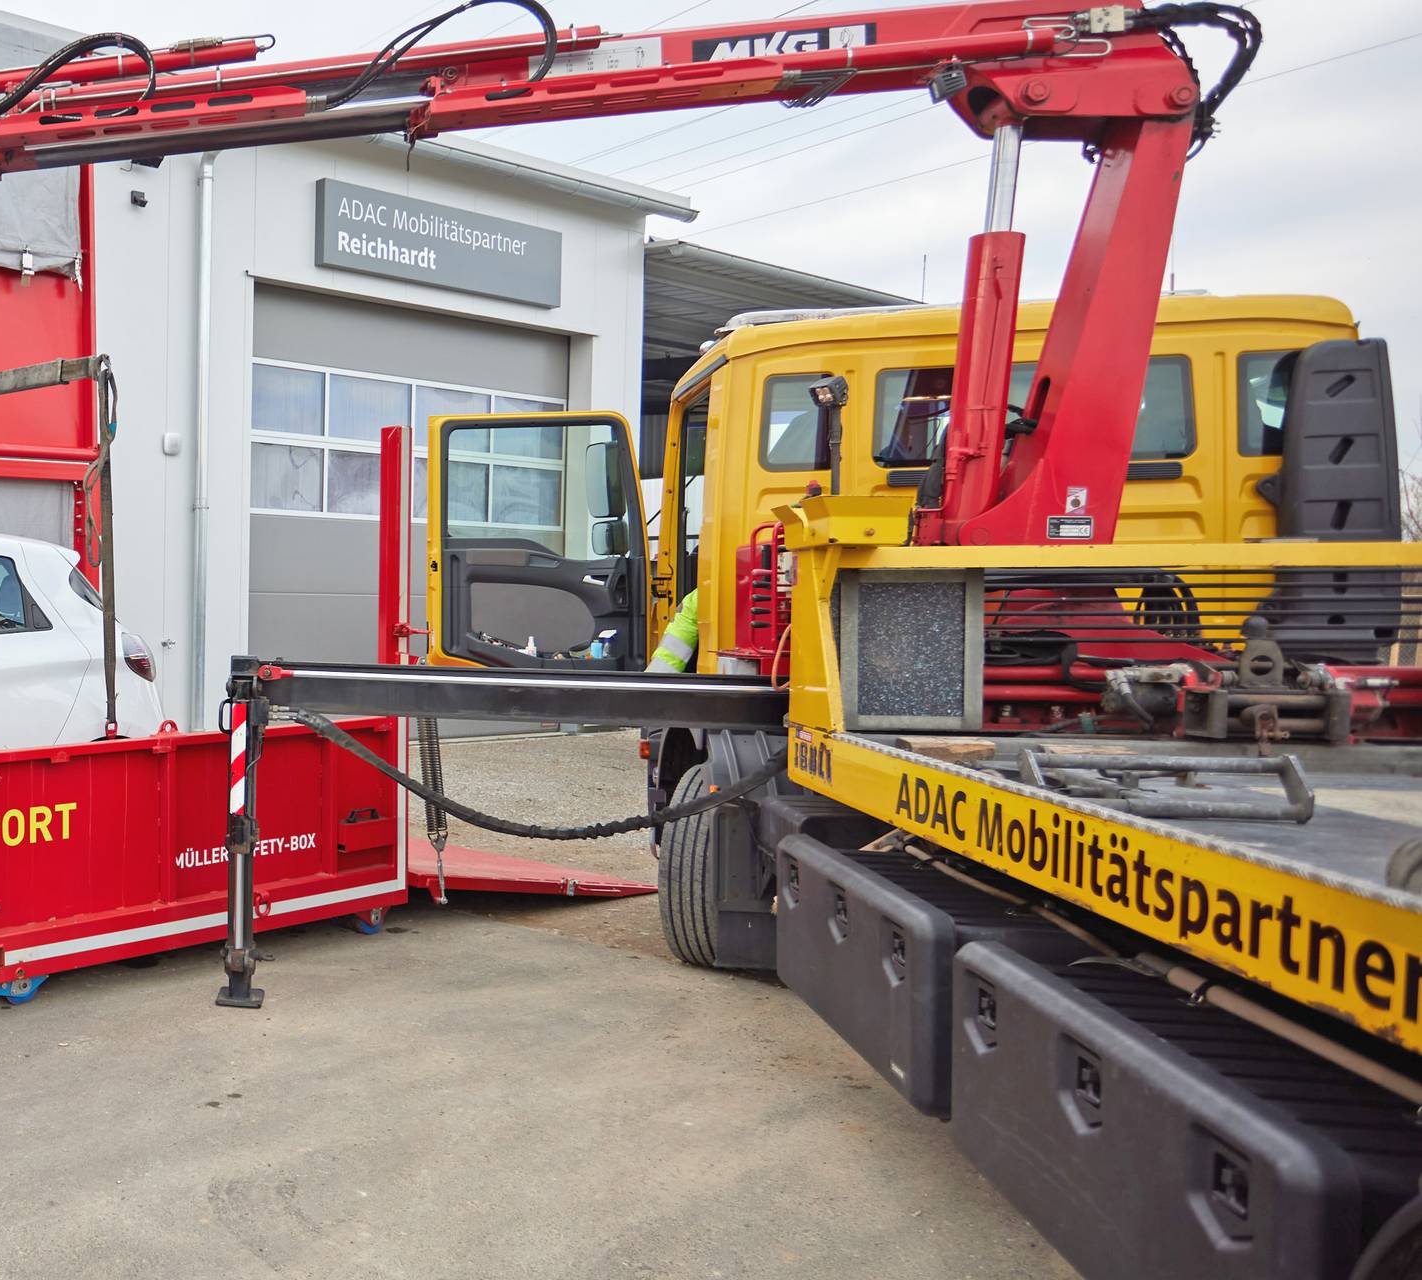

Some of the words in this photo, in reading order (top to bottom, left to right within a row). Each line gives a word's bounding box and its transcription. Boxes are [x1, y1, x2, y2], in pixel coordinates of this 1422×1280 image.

[709, 31, 819, 62] MKG
[337, 231, 437, 270] Reichhardt
[338, 197, 387, 227] ADAC
[393, 209, 527, 256] Mobilitätspartner
[895, 772, 967, 842] ADAC
